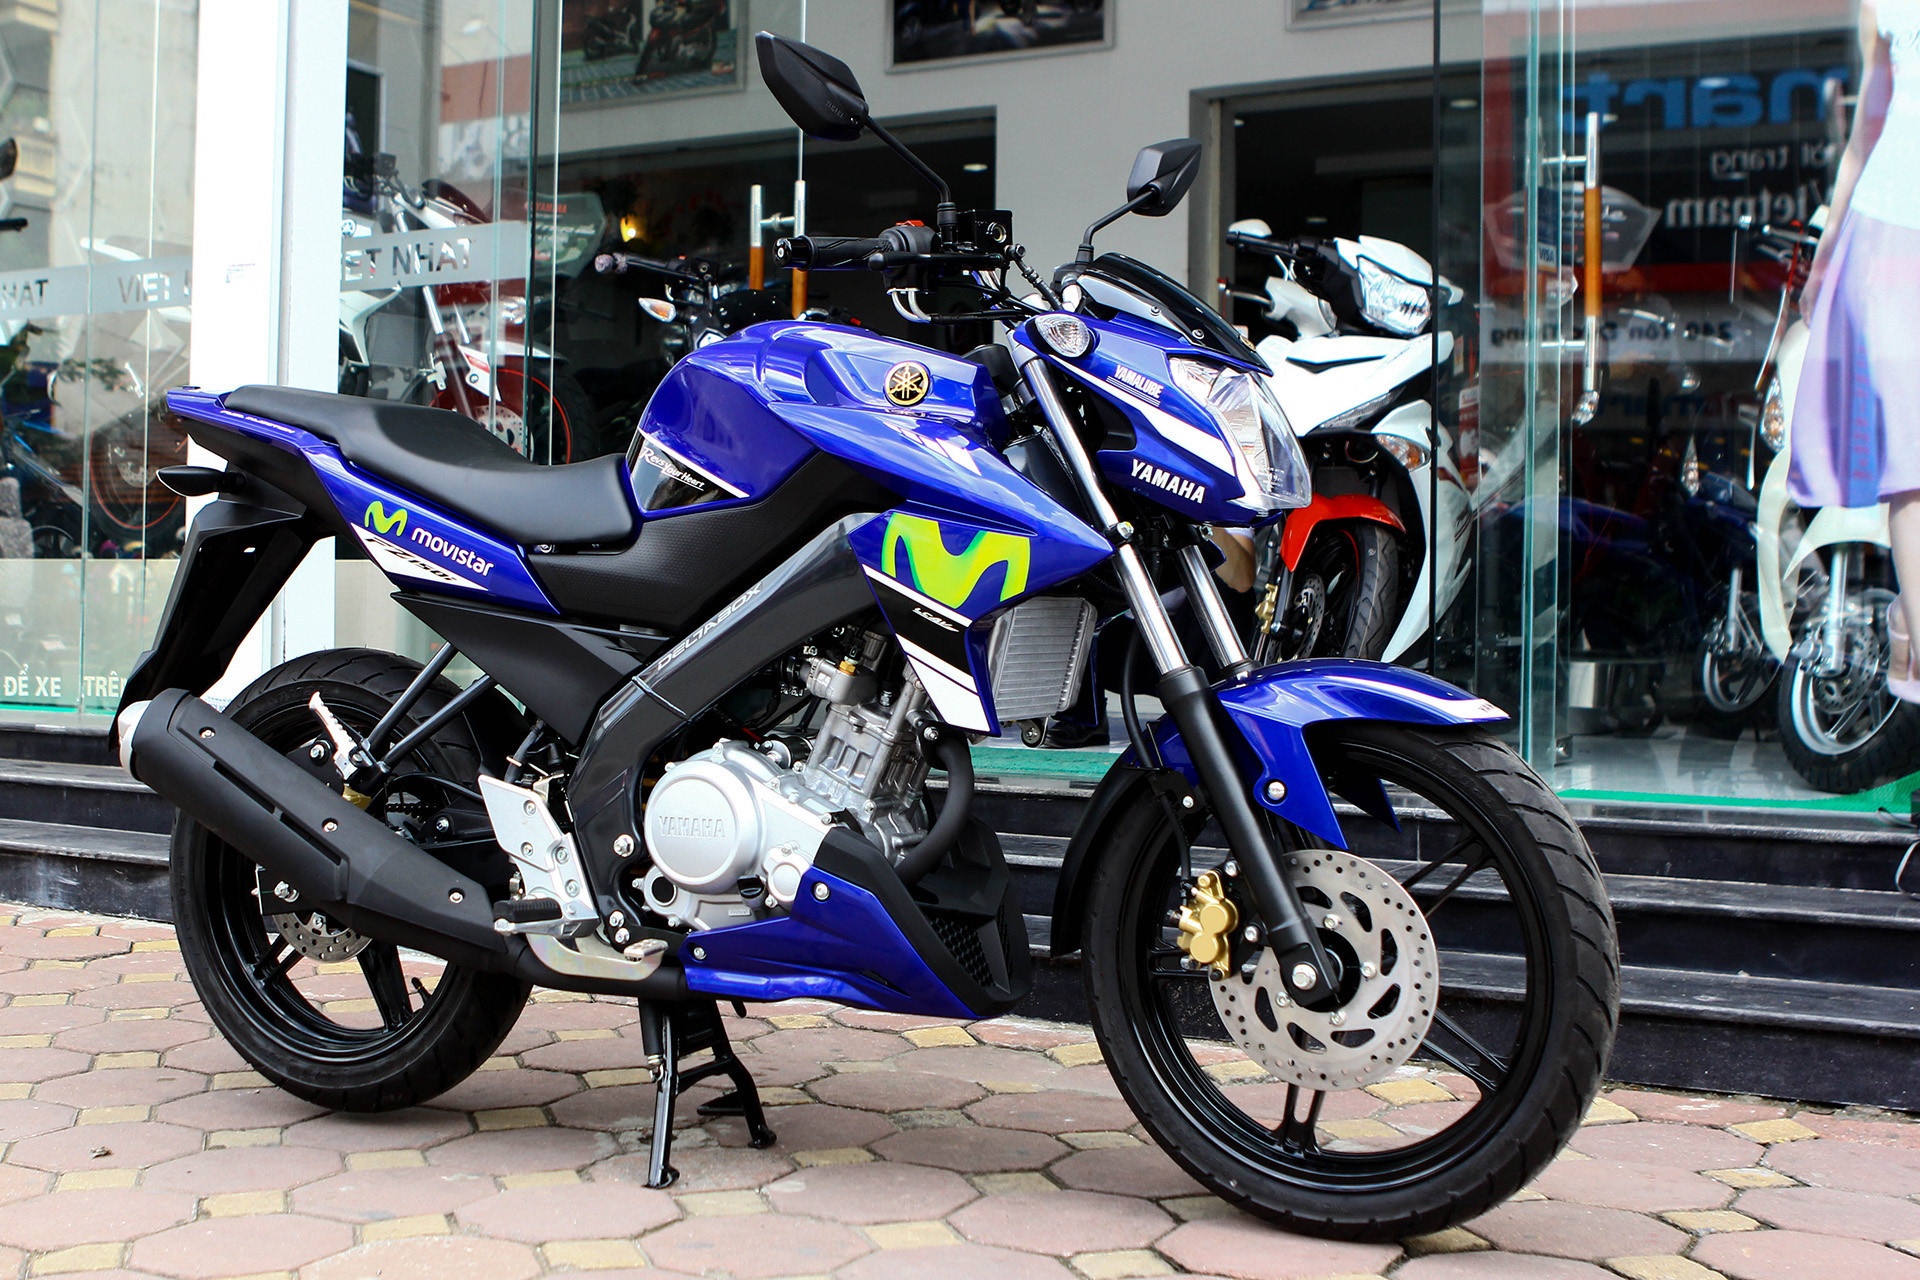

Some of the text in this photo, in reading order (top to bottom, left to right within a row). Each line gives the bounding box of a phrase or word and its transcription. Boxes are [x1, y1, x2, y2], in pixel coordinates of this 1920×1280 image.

[535, 202, 568, 213] YAMHA
[1114, 364, 1164, 399] YAMALUBE
[1130, 458, 1206, 504] YAMAHA
[411, 527, 495, 577] movistar
[657, 582, 762, 671] DELTABOX
[4, 664, 29, 697] ĐỂ
[35, 677, 61, 697] XE
[659, 816, 726, 839] YAMAHA
